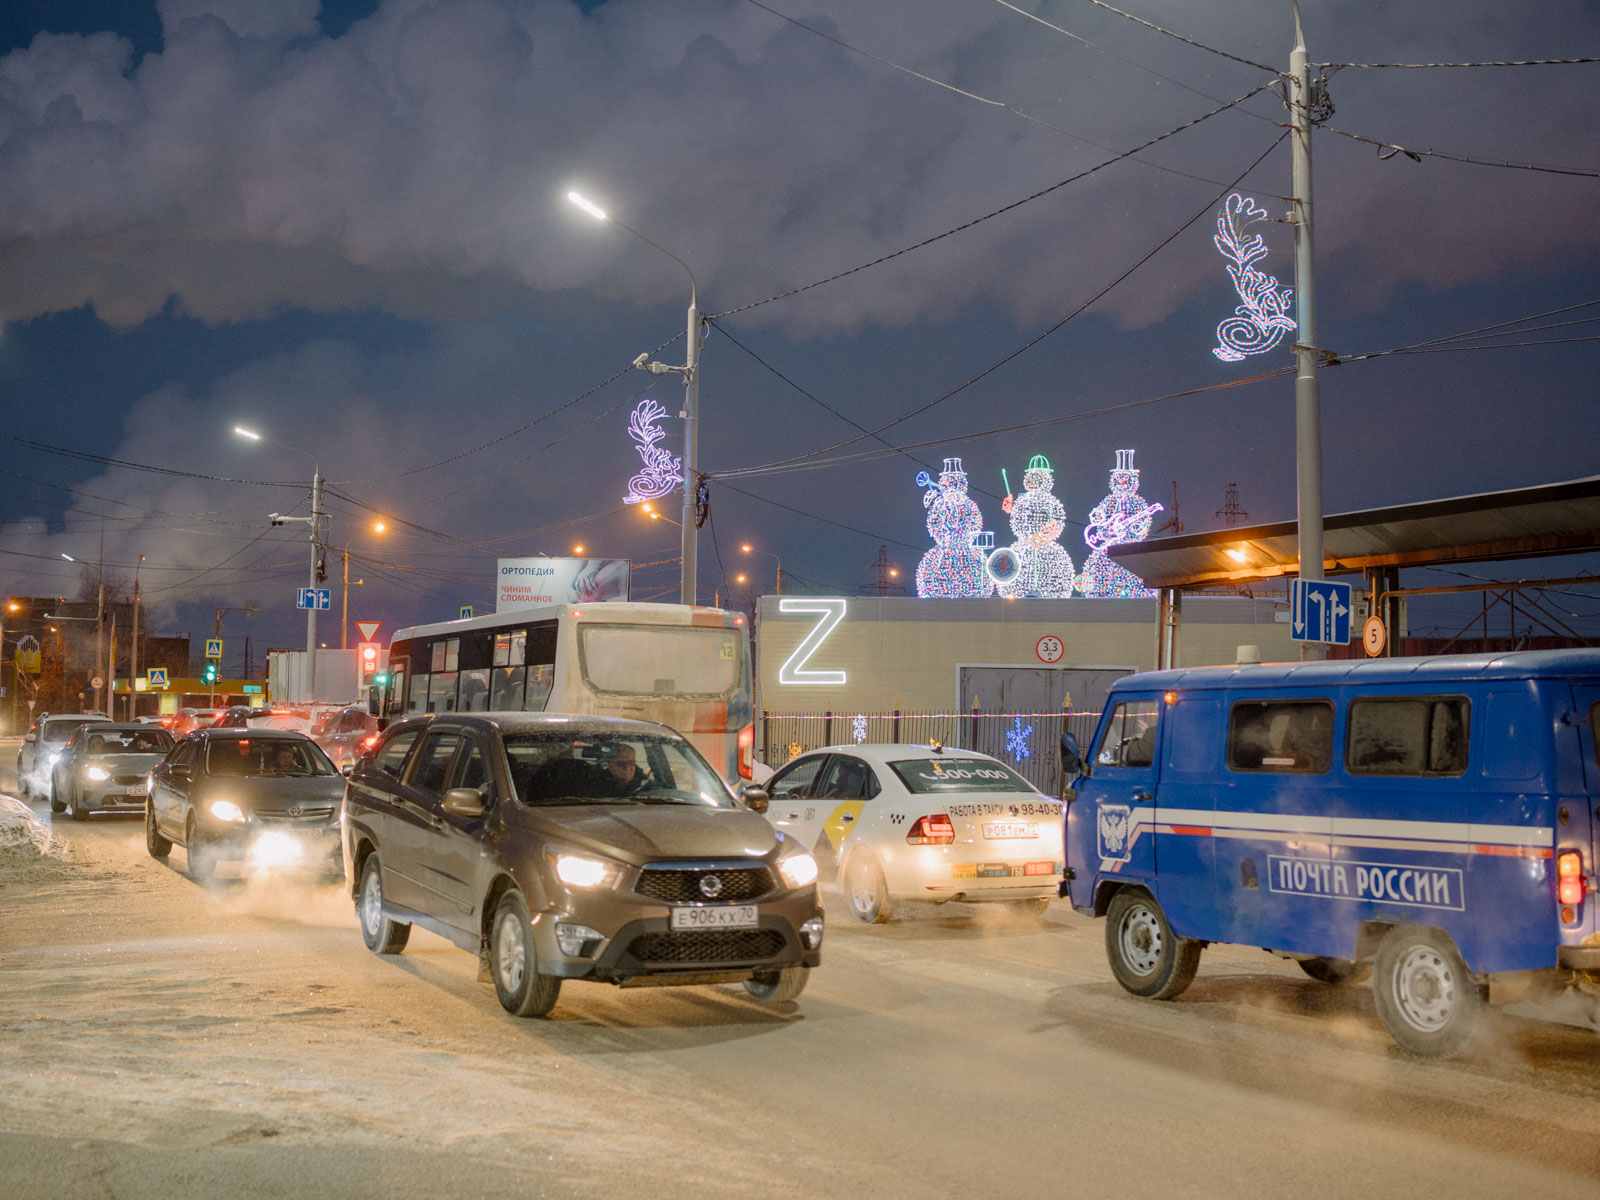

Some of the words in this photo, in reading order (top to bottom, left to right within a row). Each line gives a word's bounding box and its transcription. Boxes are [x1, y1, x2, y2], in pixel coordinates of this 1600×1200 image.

[501, 567, 555, 576] ОРТОПЕДИЯ
[501, 585, 532, 593] ЧИНИМ
[500, 594, 553, 603] СЛОМАННОЕ
[779, 599, 846, 684] Z
[1371, 628, 1377, 644] 5
[722, 645, 734, 657] 12
[932, 769, 1010, 780] 500-000
[949, 805, 976, 817] РАБОТА
[977, 804, 983, 816] В
[983, 804, 1004, 815] ТАКСИ
[1279, 860, 1349, 895] ПОЧТА
[1355, 866, 1450, 904] РОССИИ
